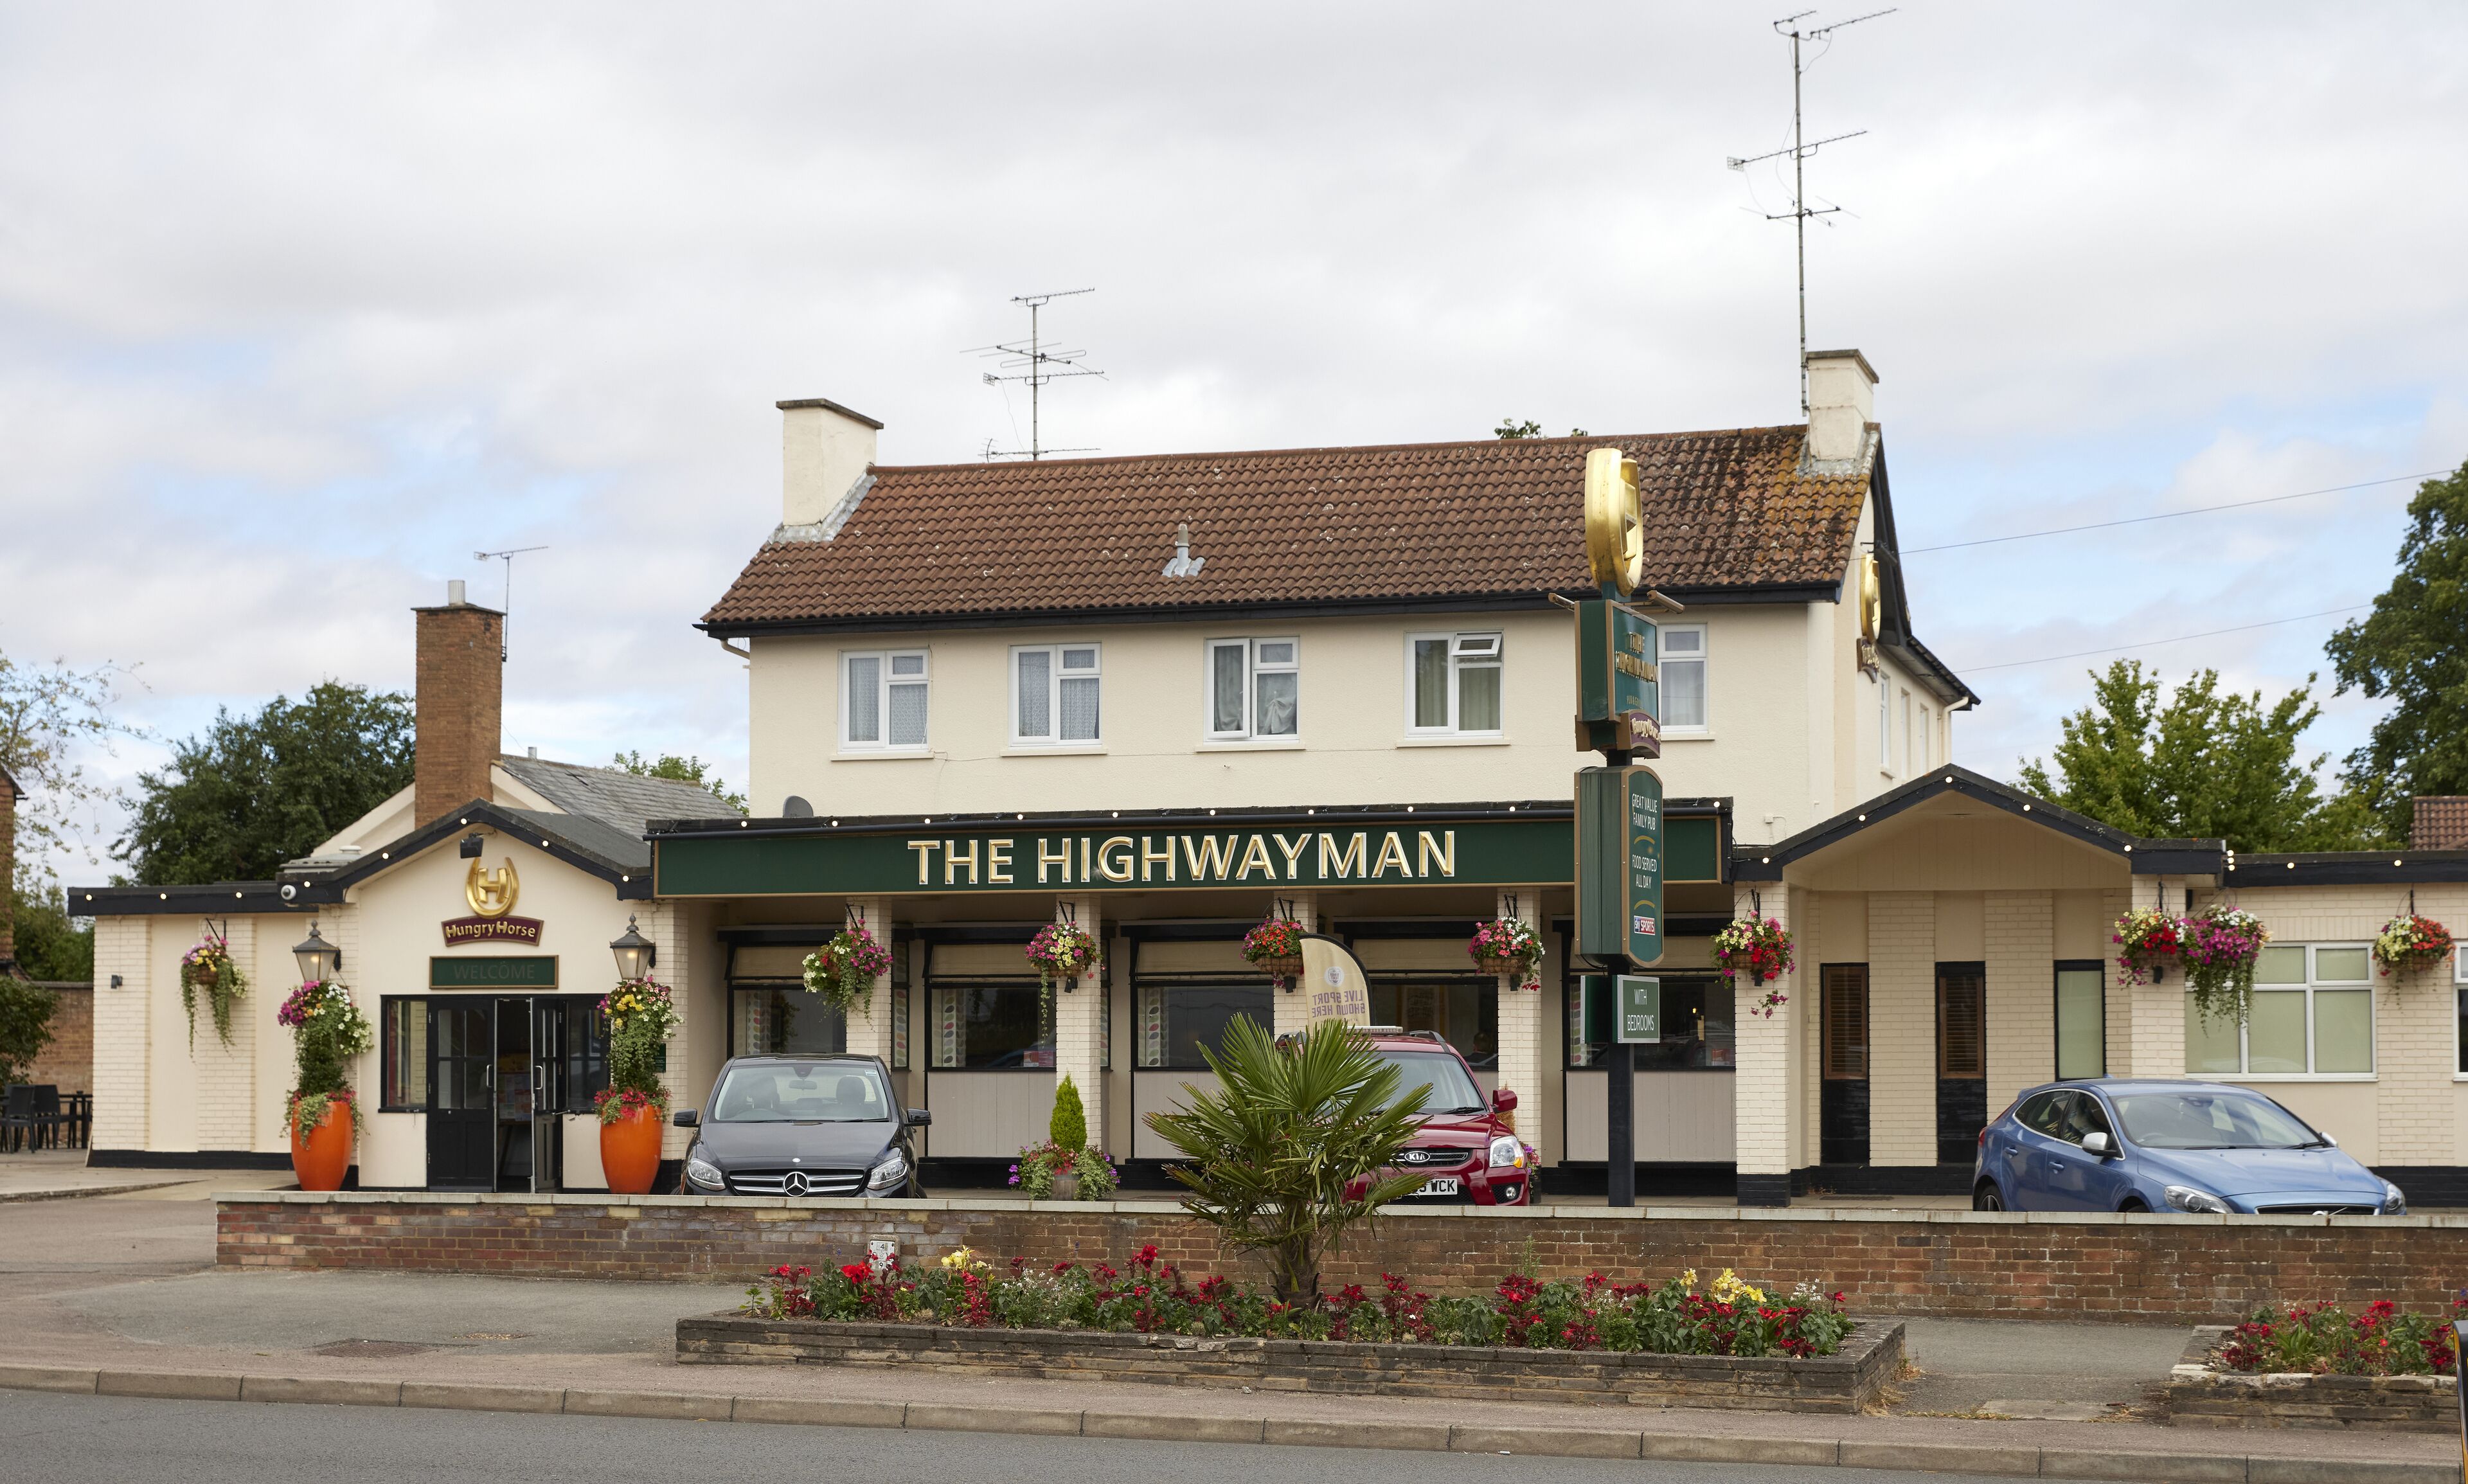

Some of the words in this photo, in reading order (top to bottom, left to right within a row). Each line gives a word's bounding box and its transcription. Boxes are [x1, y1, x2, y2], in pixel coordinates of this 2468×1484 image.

[1632, 793, 1644, 809] GREAT
[1644, 797, 1658, 813] VALUE
[1633, 812, 1647, 828] FAMILY
[1647, 816, 1656, 830] PUB
[908, 839, 1014, 885] THE
[1037, 830, 1455, 883] HIGHWAYMAN
[1632, 854, 1642, 870] FOOD
[1642, 857, 1657, 872] SERVED
[1643, 875, 1652, 889] DAY
[445, 924, 495, 938] Hungry
[496, 920, 536, 938] Horse
[1640, 920, 1654, 933] SPORTS
[452, 964, 535, 980] WELCOME
[1634, 988, 1647, 1005] WITH
[1627, 1014, 1654, 1031] BEDROOMS
[1431, 1179, 1455, 1192] WCK
